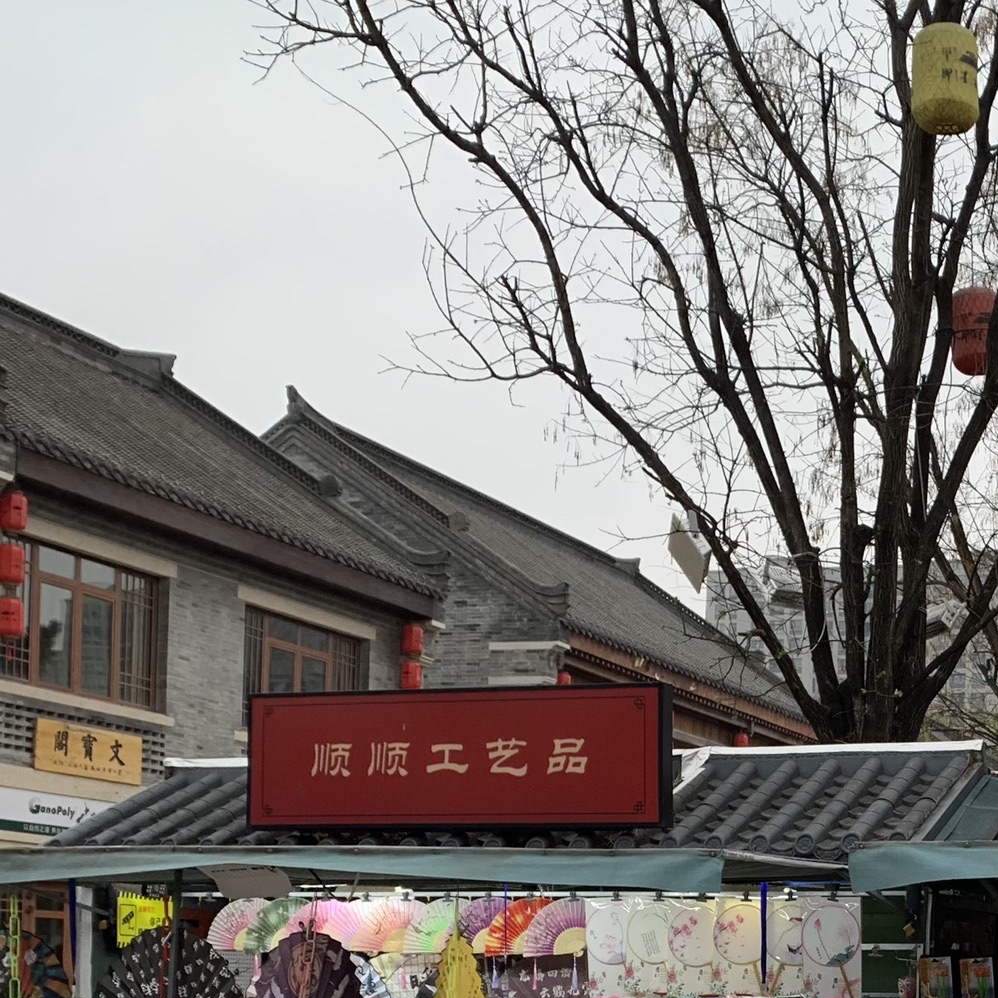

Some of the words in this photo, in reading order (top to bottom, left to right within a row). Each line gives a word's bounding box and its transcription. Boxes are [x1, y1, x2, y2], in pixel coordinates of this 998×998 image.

[310, 737, 589, 778] 顺顺工艺品
[28, 797, 76, 819] GanoPoly
